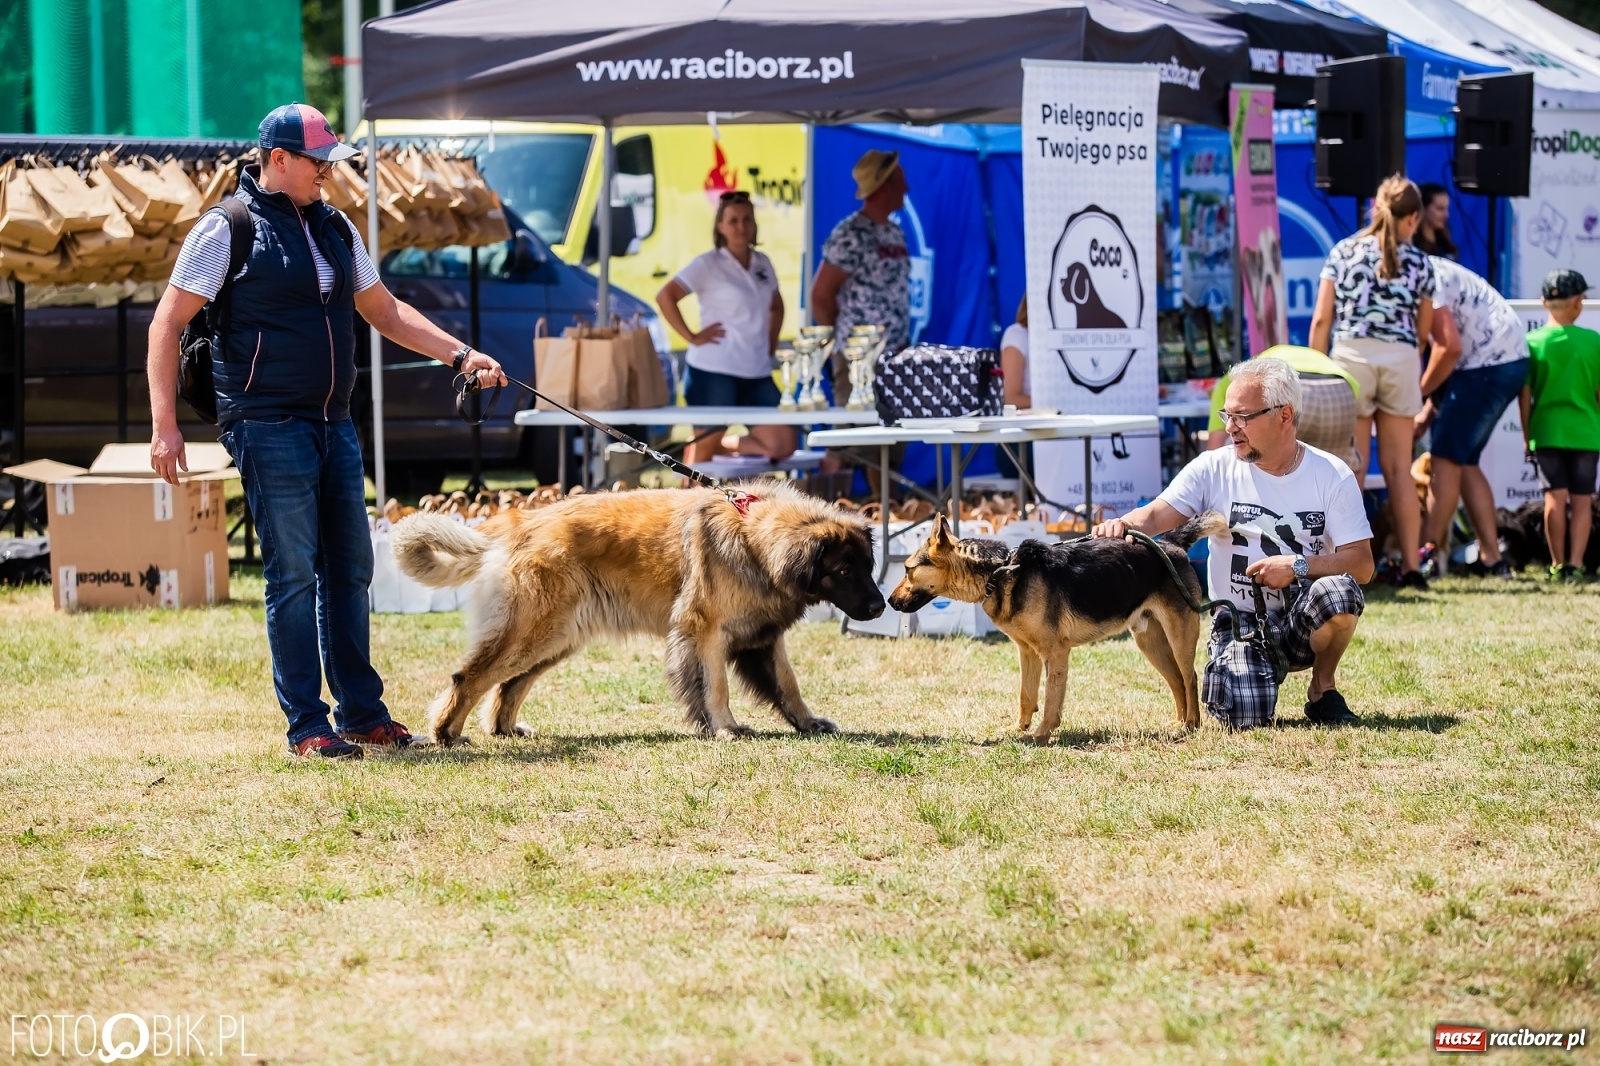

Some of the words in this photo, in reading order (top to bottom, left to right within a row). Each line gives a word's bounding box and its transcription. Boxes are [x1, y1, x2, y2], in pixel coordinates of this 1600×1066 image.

[576, 48, 855, 83] www.raciborz.pl
[1041, 102, 1144, 133] Pielęgnacja
[1037, 136, 1111, 165] Twojego
[1117, 144, 1148, 165] psa
[1531, 129, 1600, 159] ropiDog
[1089, 238, 1122, 267] Coco
[1232, 504, 1262, 515] MOTUL
[76, 569, 135, 587] Tropical
